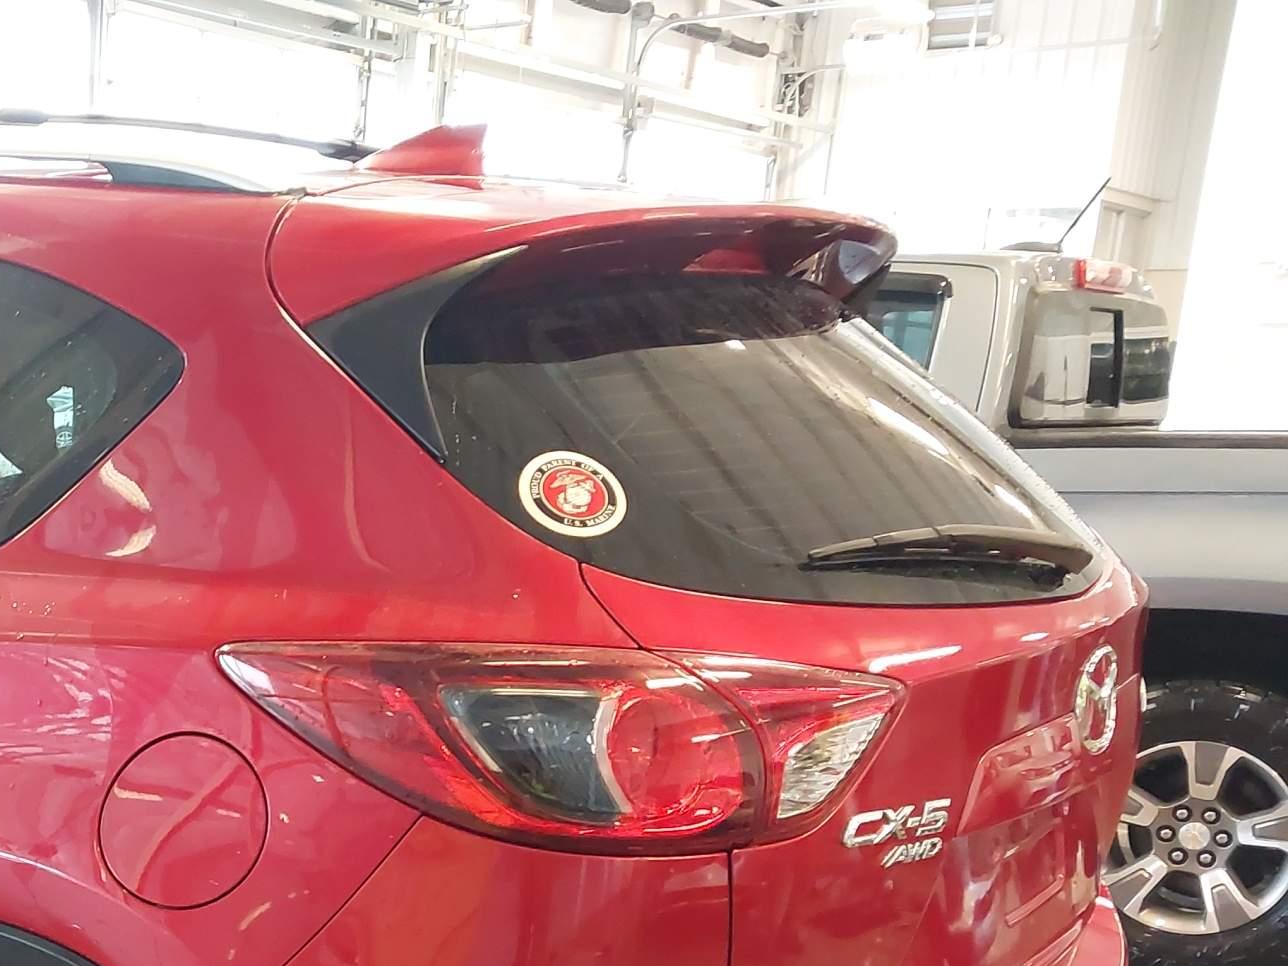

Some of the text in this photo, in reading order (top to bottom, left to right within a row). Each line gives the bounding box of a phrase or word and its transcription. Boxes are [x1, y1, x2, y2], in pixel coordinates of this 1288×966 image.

[541, 459, 576, 471] PARENT
[564, 504, 617, 527] U.S. MARINE
[843, 797, 952, 849] CX-5
[881, 836, 943, 869] AWD
